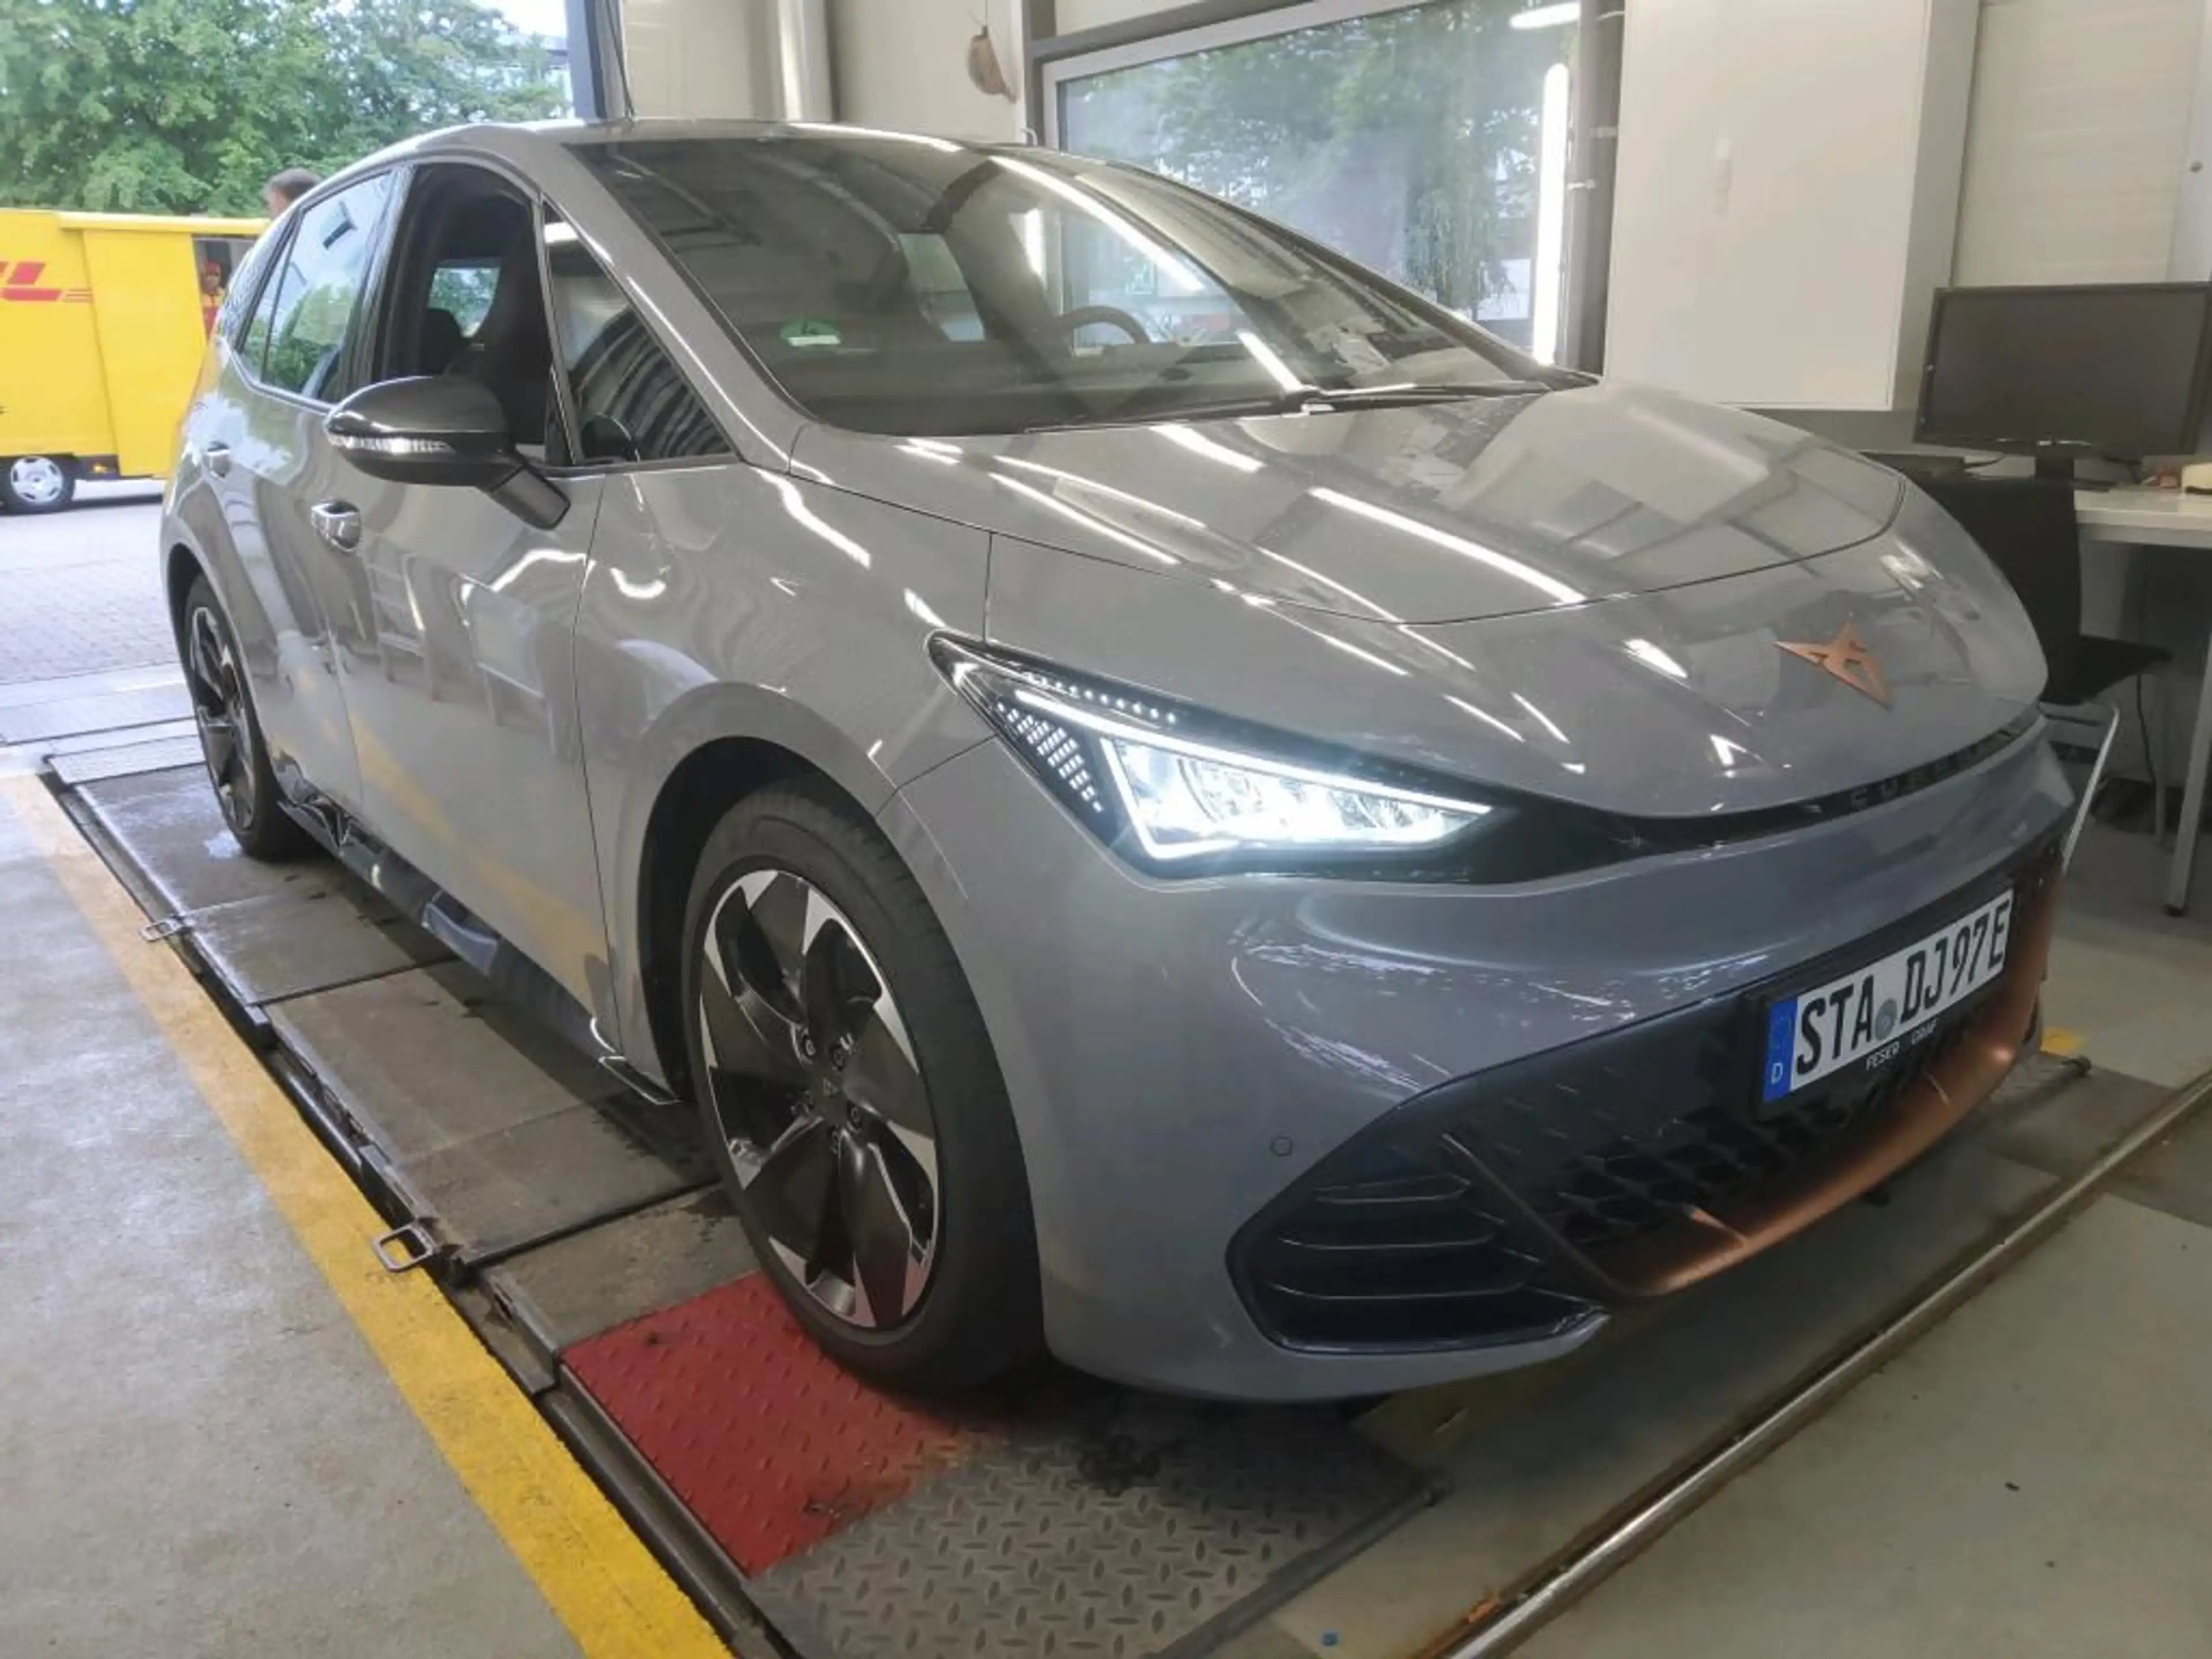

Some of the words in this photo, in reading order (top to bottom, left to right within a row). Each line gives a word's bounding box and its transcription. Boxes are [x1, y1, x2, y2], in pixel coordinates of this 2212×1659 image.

[0, 262, 63, 302] L
[1797, 975, 1873, 1074] STA
[1771, 1062, 1783, 1084] D
